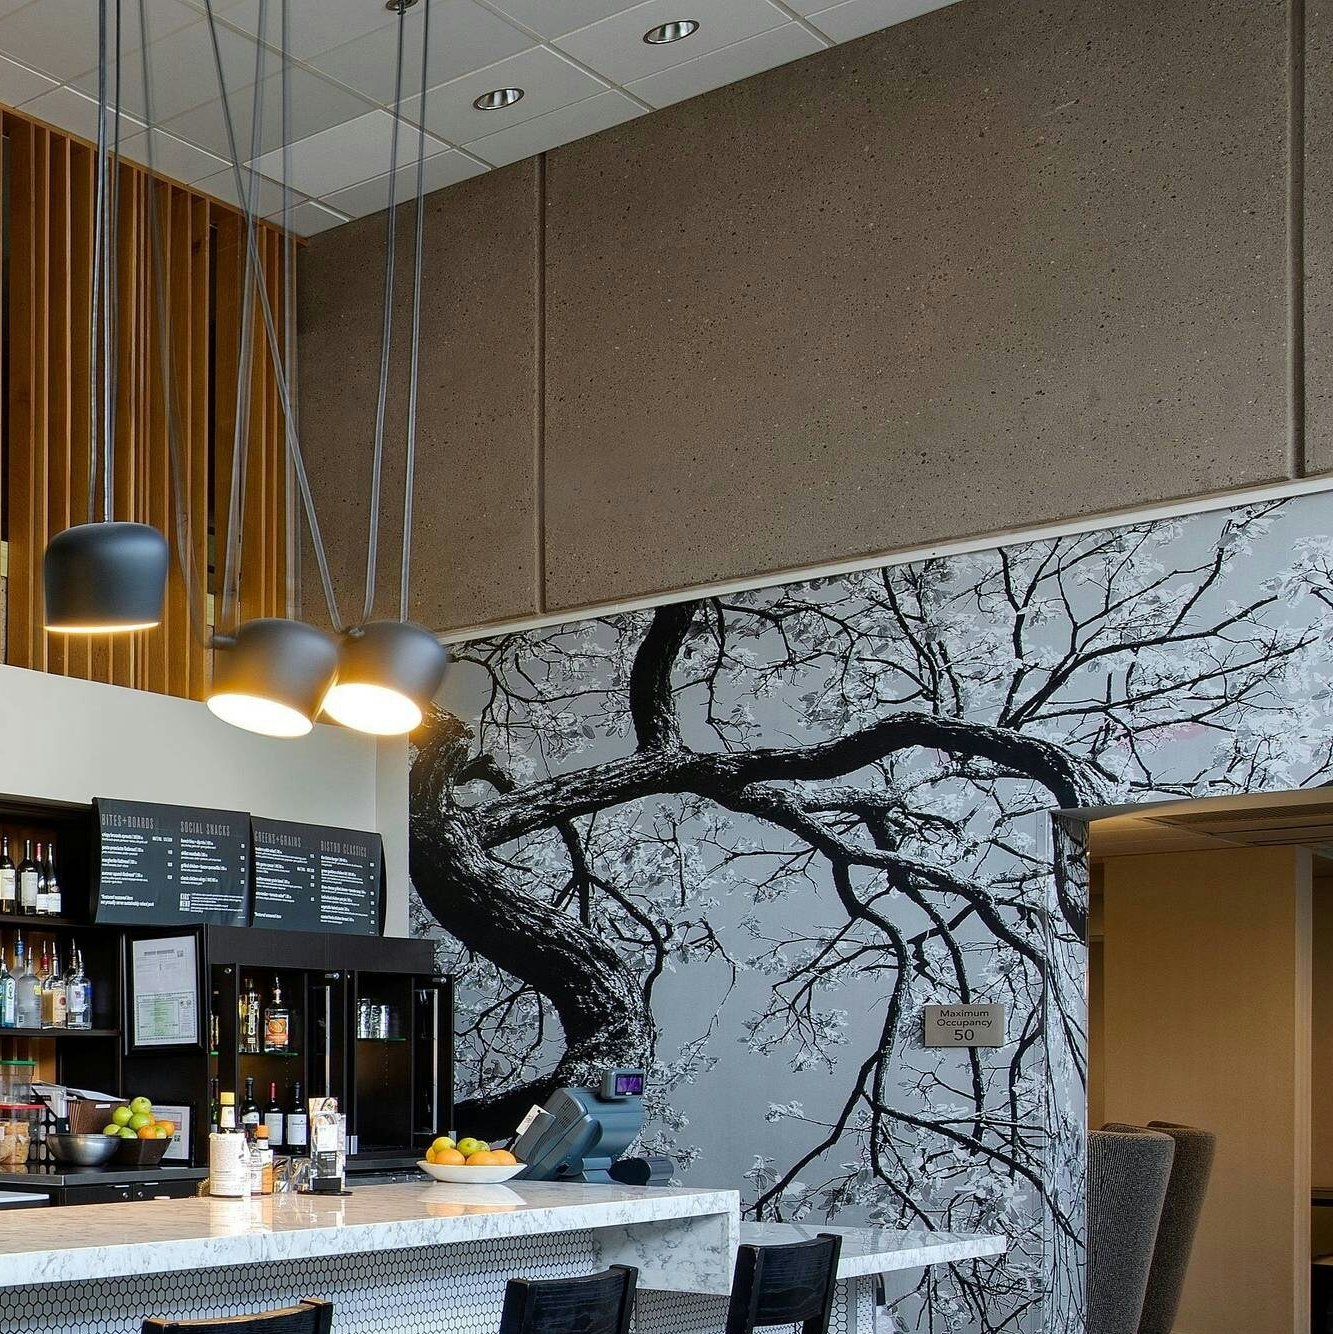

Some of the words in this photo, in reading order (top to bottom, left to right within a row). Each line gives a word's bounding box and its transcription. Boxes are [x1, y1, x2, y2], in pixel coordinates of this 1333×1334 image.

[180, 821, 203, 834] SOCIAL
[206, 823, 230, 837] SNACKS
[320, 840, 341, 854] BISTRO
[342, 843, 367, 858] CLASSICS
[940, 1009, 989, 1017] Maximum
[936, 1018, 993, 1028] Occupancy
[953, 1029, 975, 1041] 50
